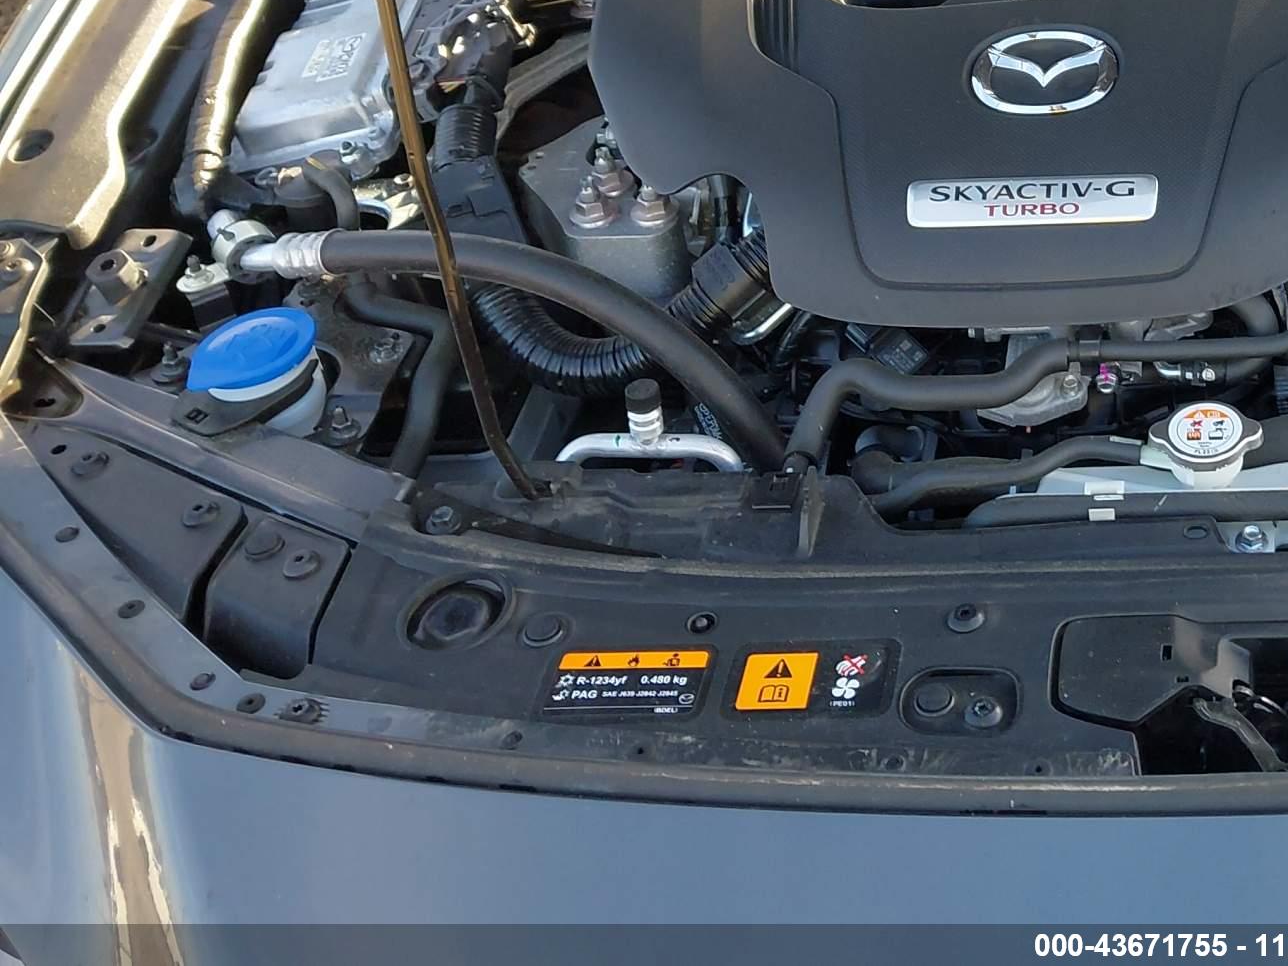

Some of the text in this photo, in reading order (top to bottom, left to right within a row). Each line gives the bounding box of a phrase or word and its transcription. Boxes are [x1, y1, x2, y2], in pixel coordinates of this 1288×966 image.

[929, 180, 1136, 202] SKYACTIV-G
[984, 202, 1080, 217] TURBO
[576, 674, 688, 686] R-1234yf 0.480 kg
[571, 689, 598, 699] PAG
[602, 690, 618, 698] SAE
